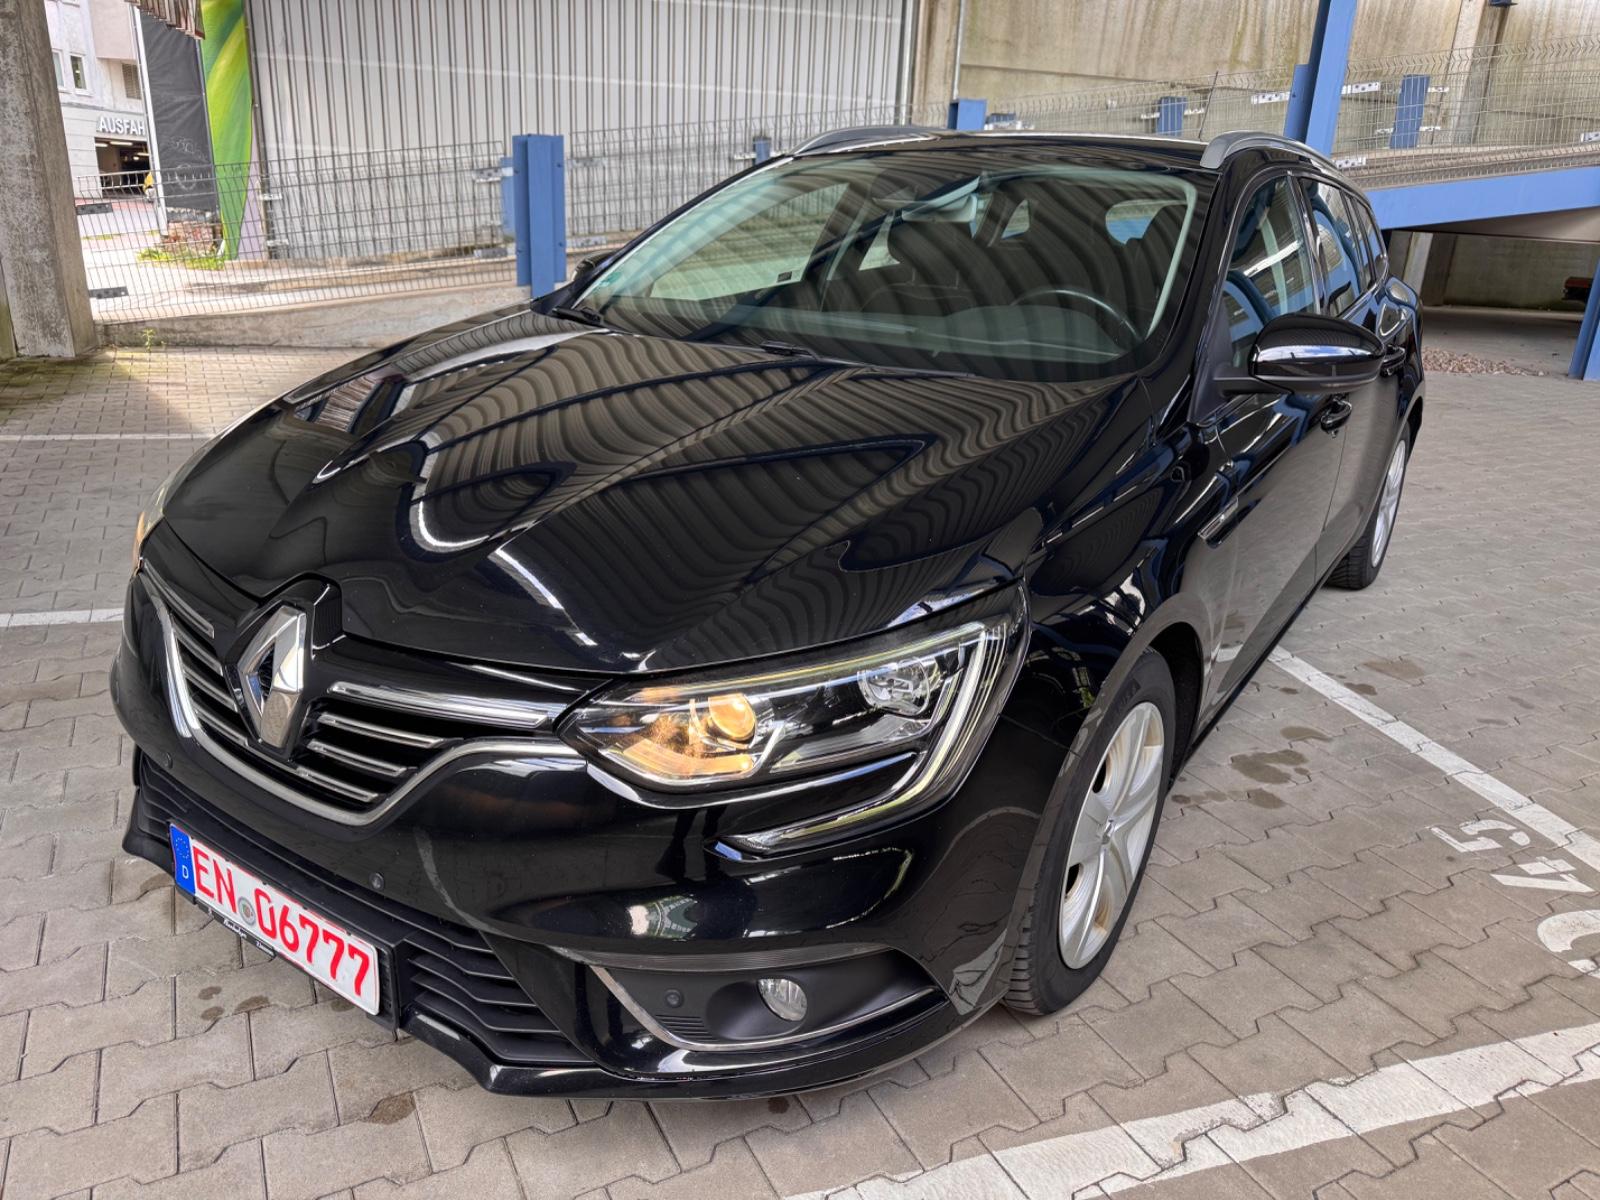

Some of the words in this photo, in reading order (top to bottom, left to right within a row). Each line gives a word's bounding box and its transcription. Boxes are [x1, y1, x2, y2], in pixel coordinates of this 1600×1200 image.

[182, 864, 189, 879] D
[192, 845, 238, 914] EN
[254, 887, 370, 997] 06777
